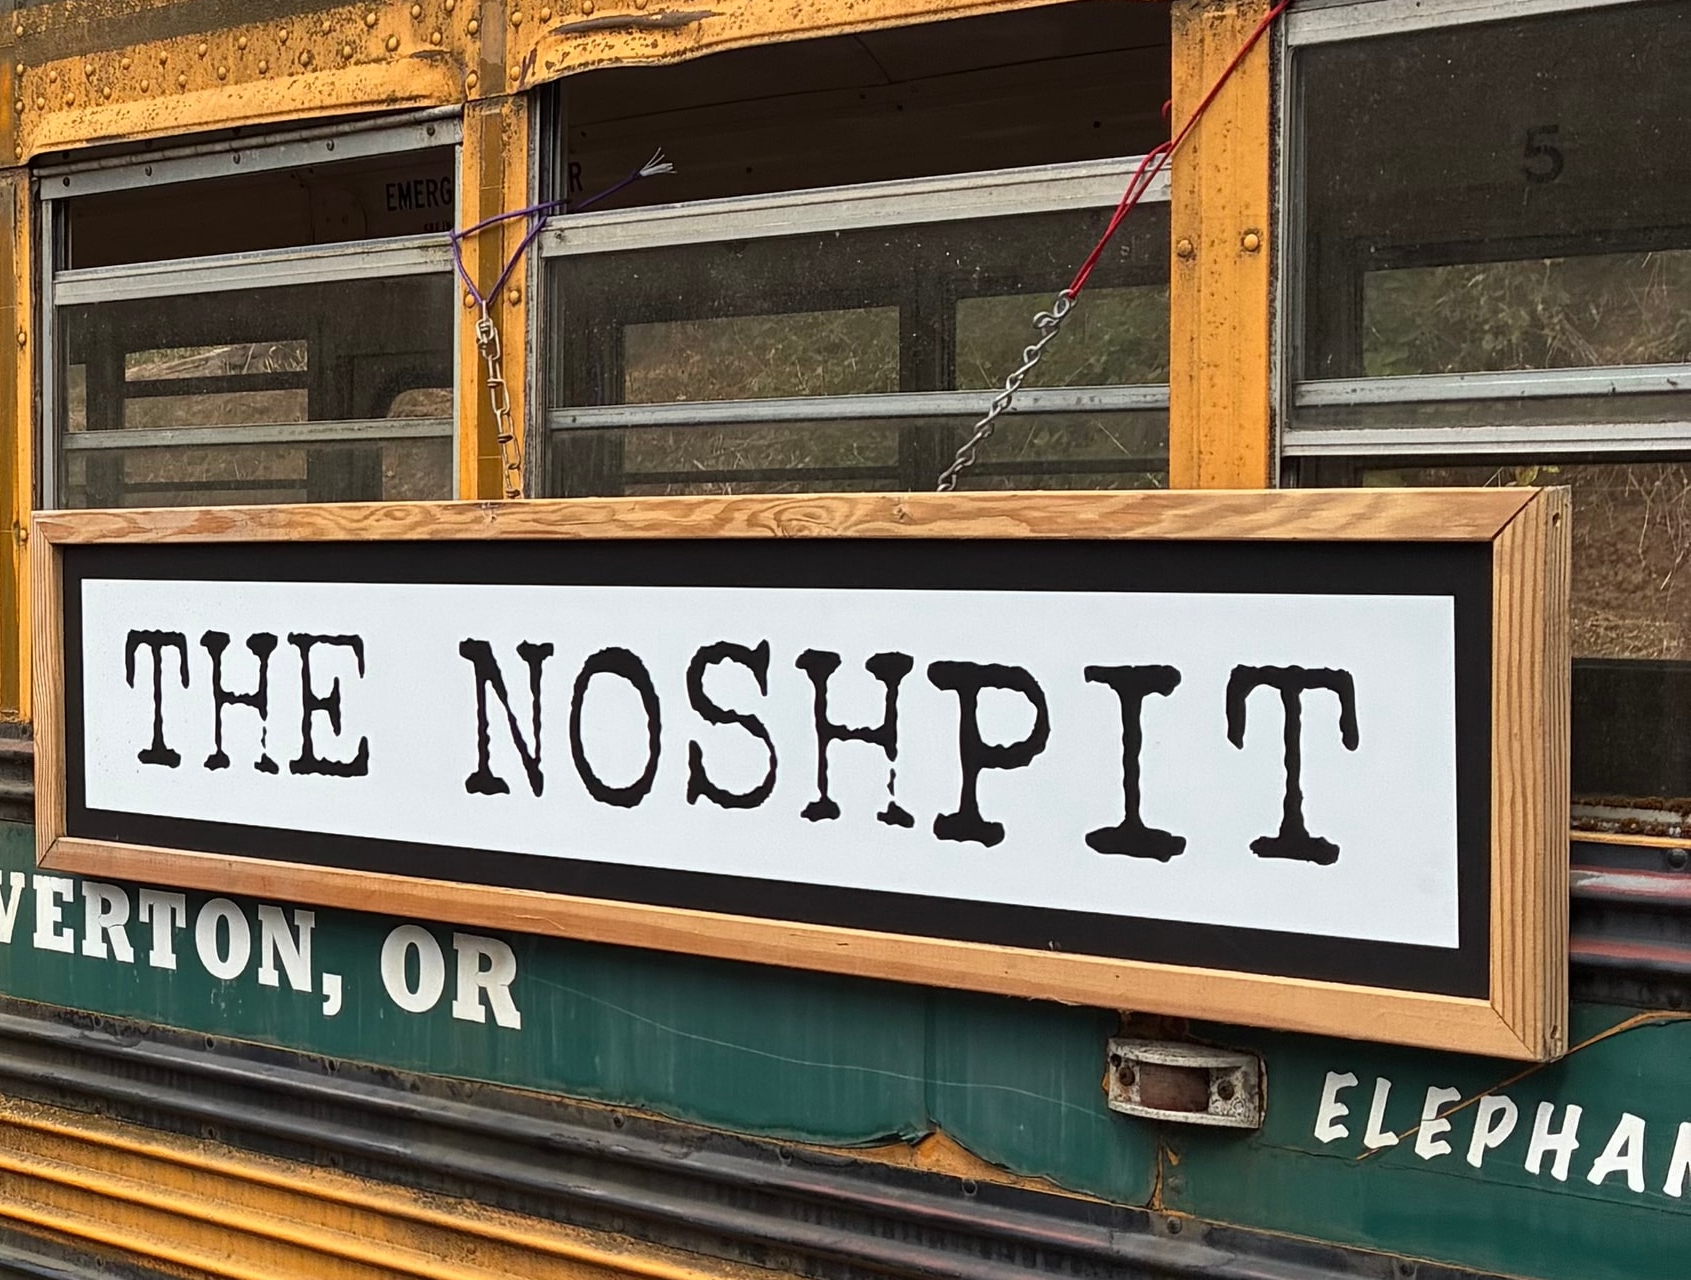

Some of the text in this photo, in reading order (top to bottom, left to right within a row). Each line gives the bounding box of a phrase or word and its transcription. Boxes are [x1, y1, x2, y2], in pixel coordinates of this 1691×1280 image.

[1523, 123, 1565, 184] 5
[124, 628, 1360, 866] THE NOSHPIT
[380, 924, 521, 1030] OR
